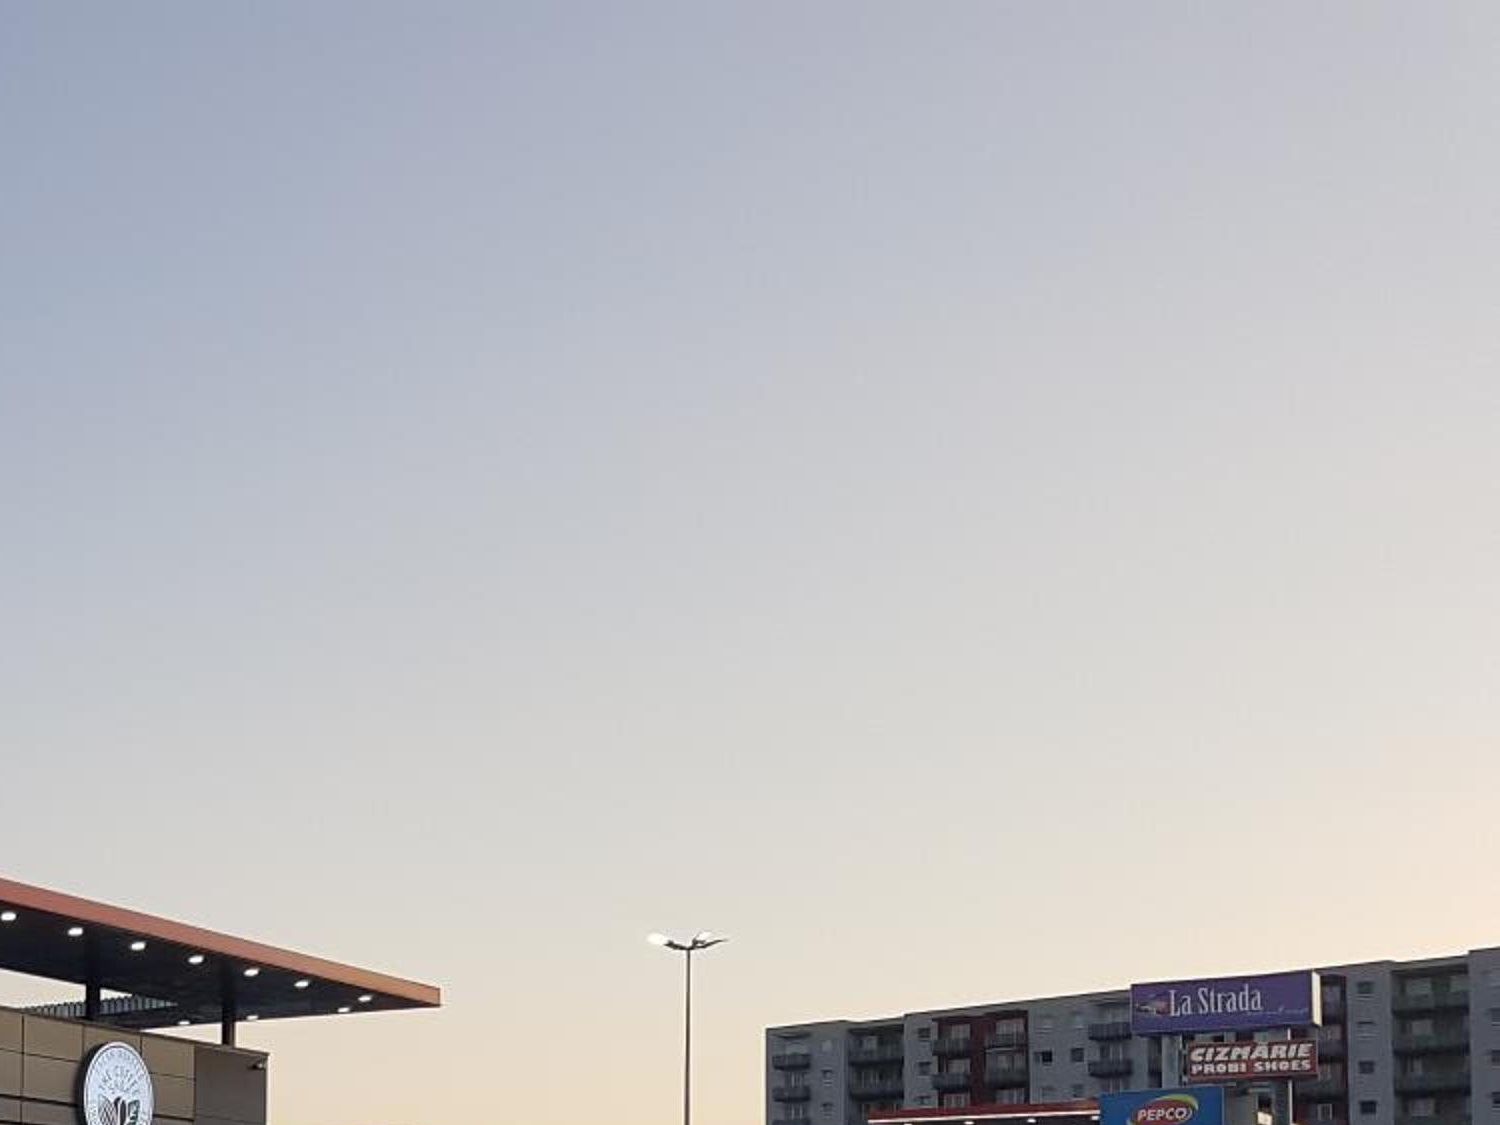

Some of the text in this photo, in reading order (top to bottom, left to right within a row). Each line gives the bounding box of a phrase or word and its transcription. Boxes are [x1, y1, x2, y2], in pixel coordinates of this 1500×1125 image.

[1168, 983, 1263, 1017] La Strada
[1190, 1059, 1312, 1075] PROBI SHOES
[1136, 1107, 1188, 1122] PEPCO
